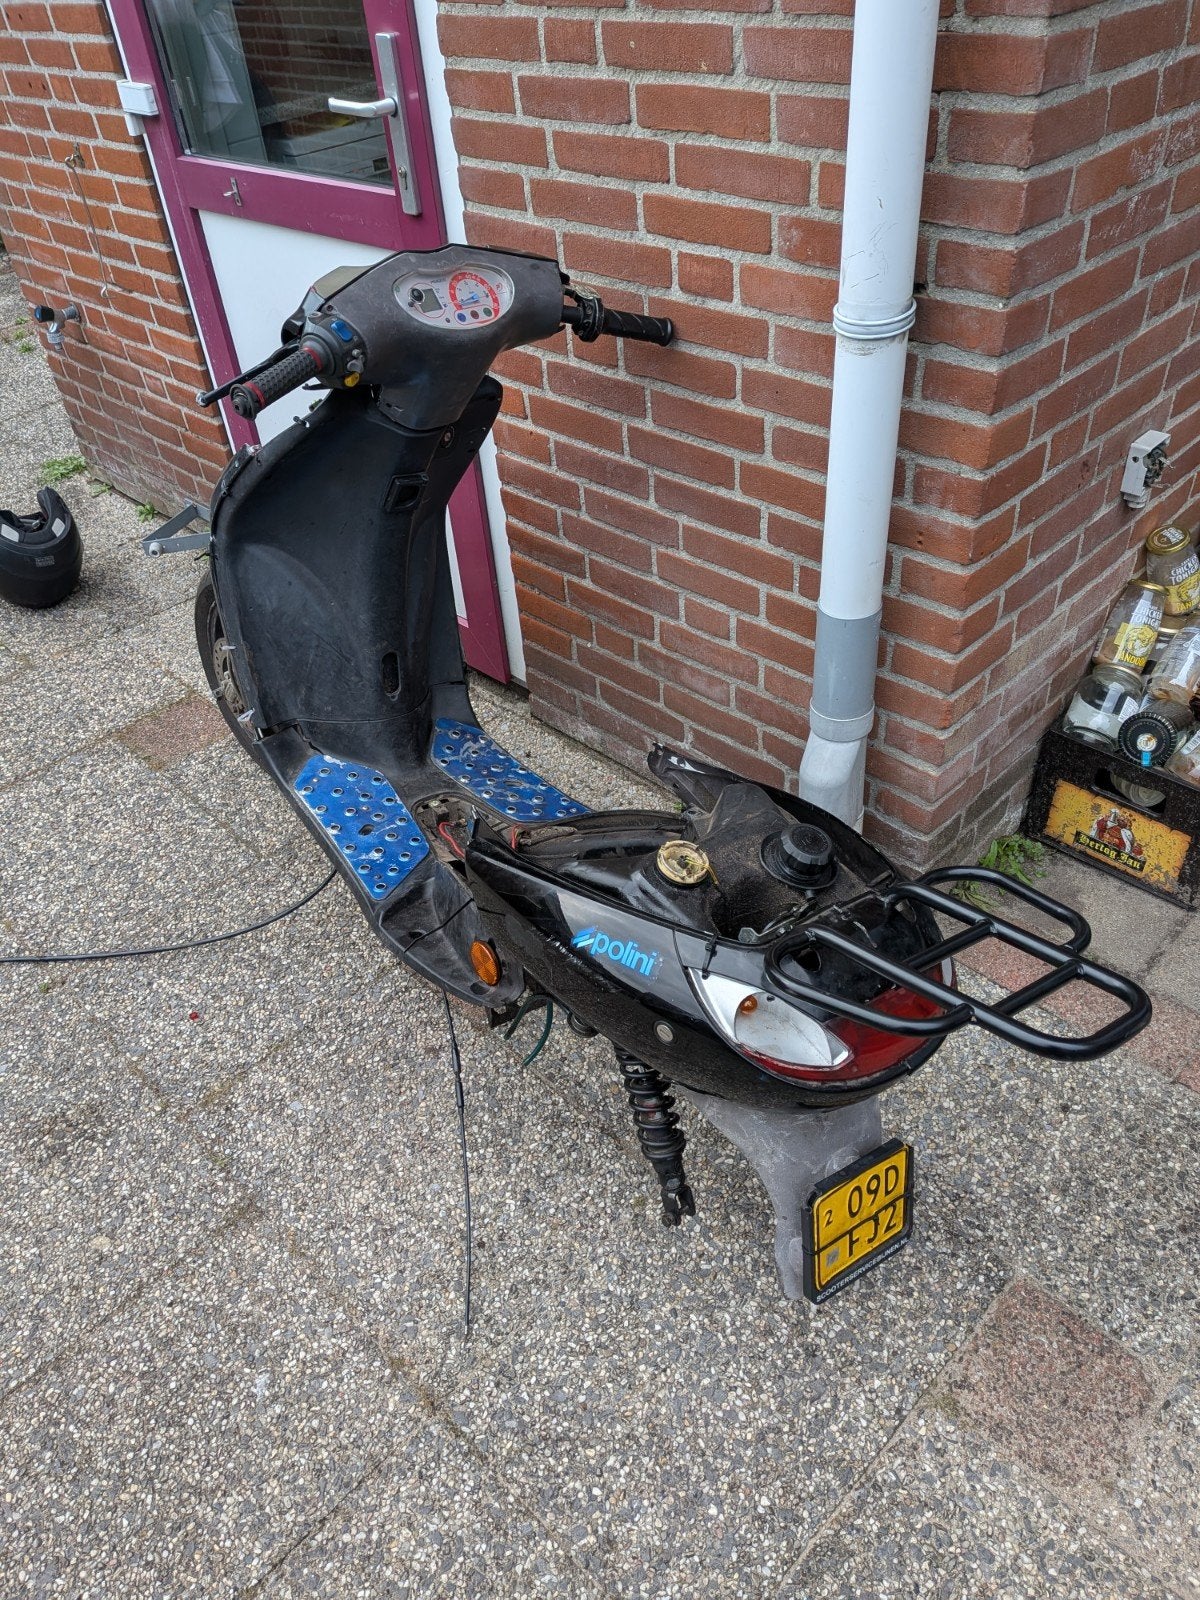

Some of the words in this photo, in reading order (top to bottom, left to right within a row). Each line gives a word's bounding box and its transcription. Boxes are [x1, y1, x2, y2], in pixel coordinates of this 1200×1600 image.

[1079, 833, 1117, 860] Hertog
[1119, 852, 1140, 869] Jan
[590, 932, 657, 976] polini
[824, 1209, 833, 1228] 2
[848, 1164, 899, 1218] 09D
